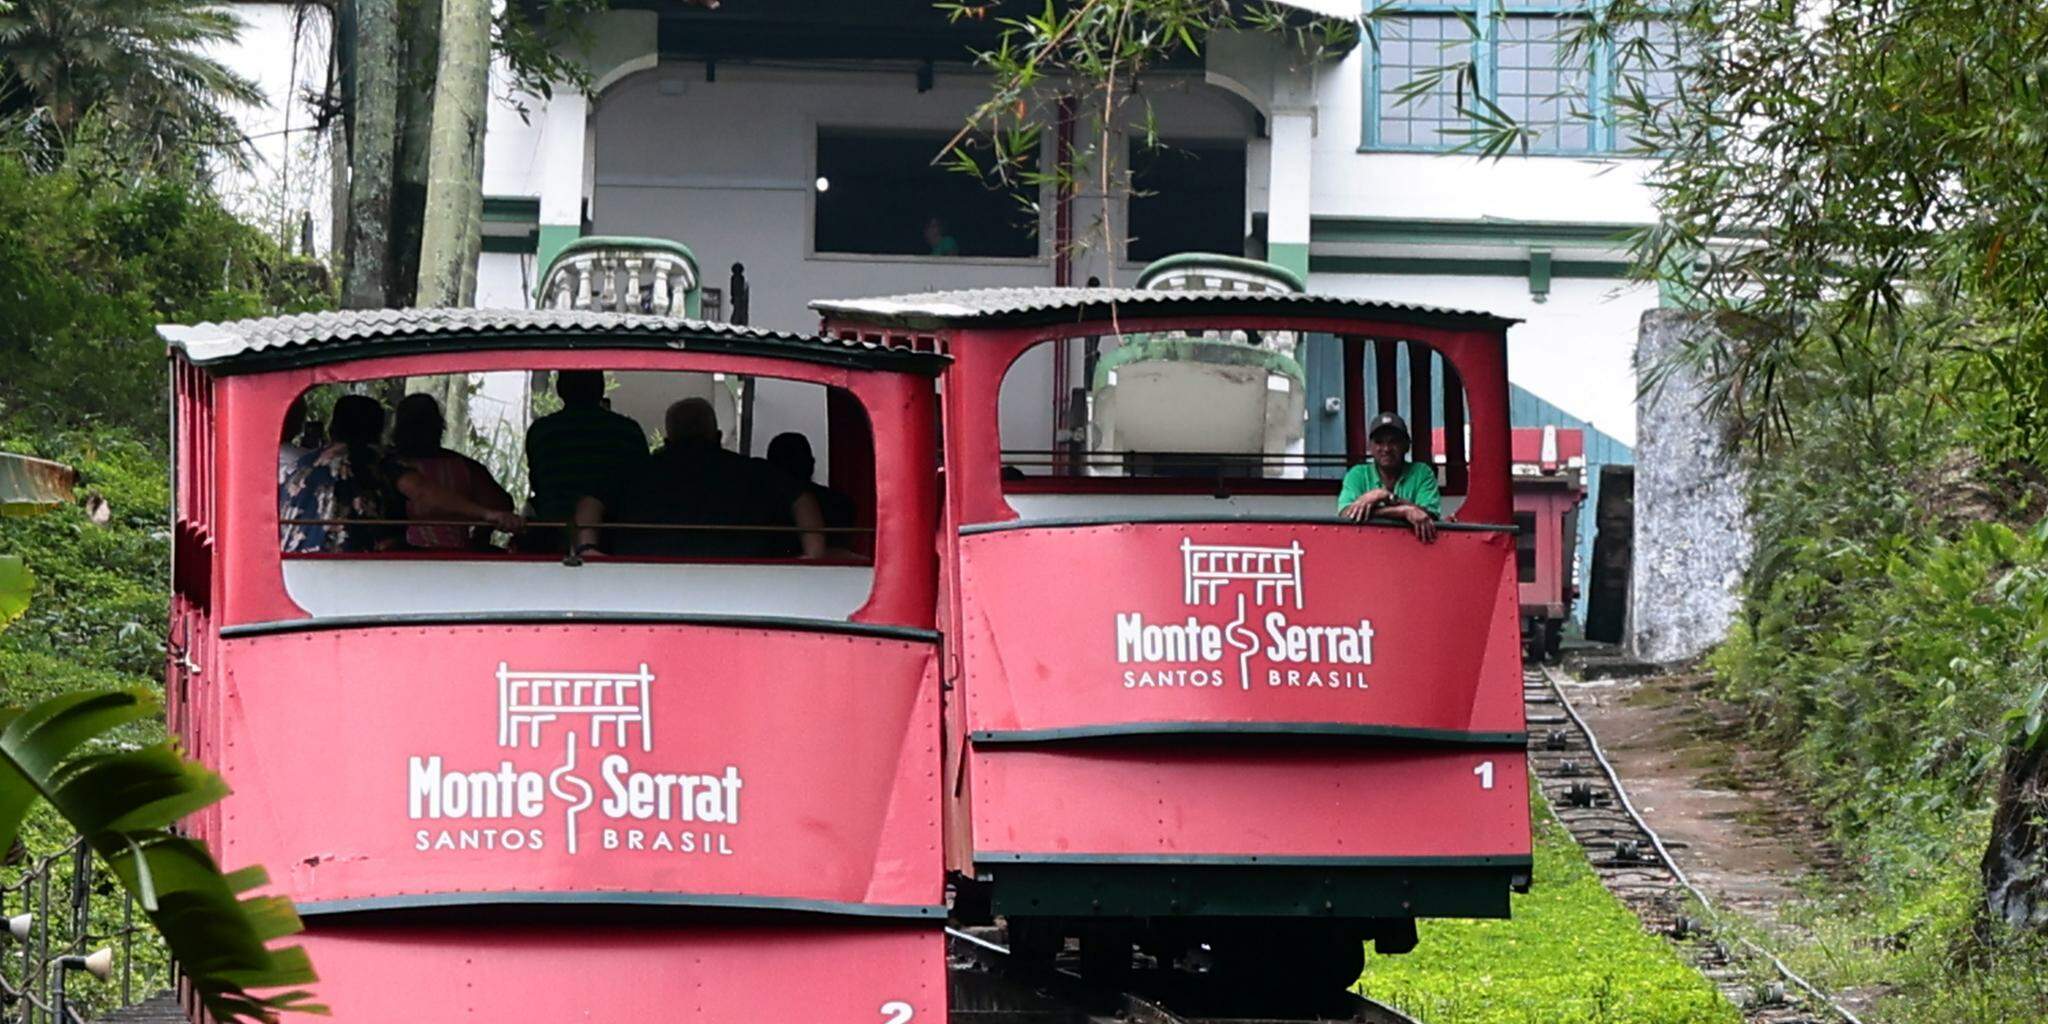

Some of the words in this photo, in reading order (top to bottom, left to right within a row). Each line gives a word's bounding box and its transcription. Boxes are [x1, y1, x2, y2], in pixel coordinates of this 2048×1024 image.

[1115, 613, 1224, 665] Monte
[1264, 611, 1375, 666] Serrat
[1122, 669, 1225, 689] SANTOS
[1268, 669, 1370, 690] BRASIL
[407, 754, 545, 821] Monte
[600, 753, 744, 826] Serrat
[1473, 761, 1494, 790] 1
[414, 828, 545, 853] SANTOS
[602, 828, 735, 856] BRASIL
[879, 1001, 914, 1024] 2
